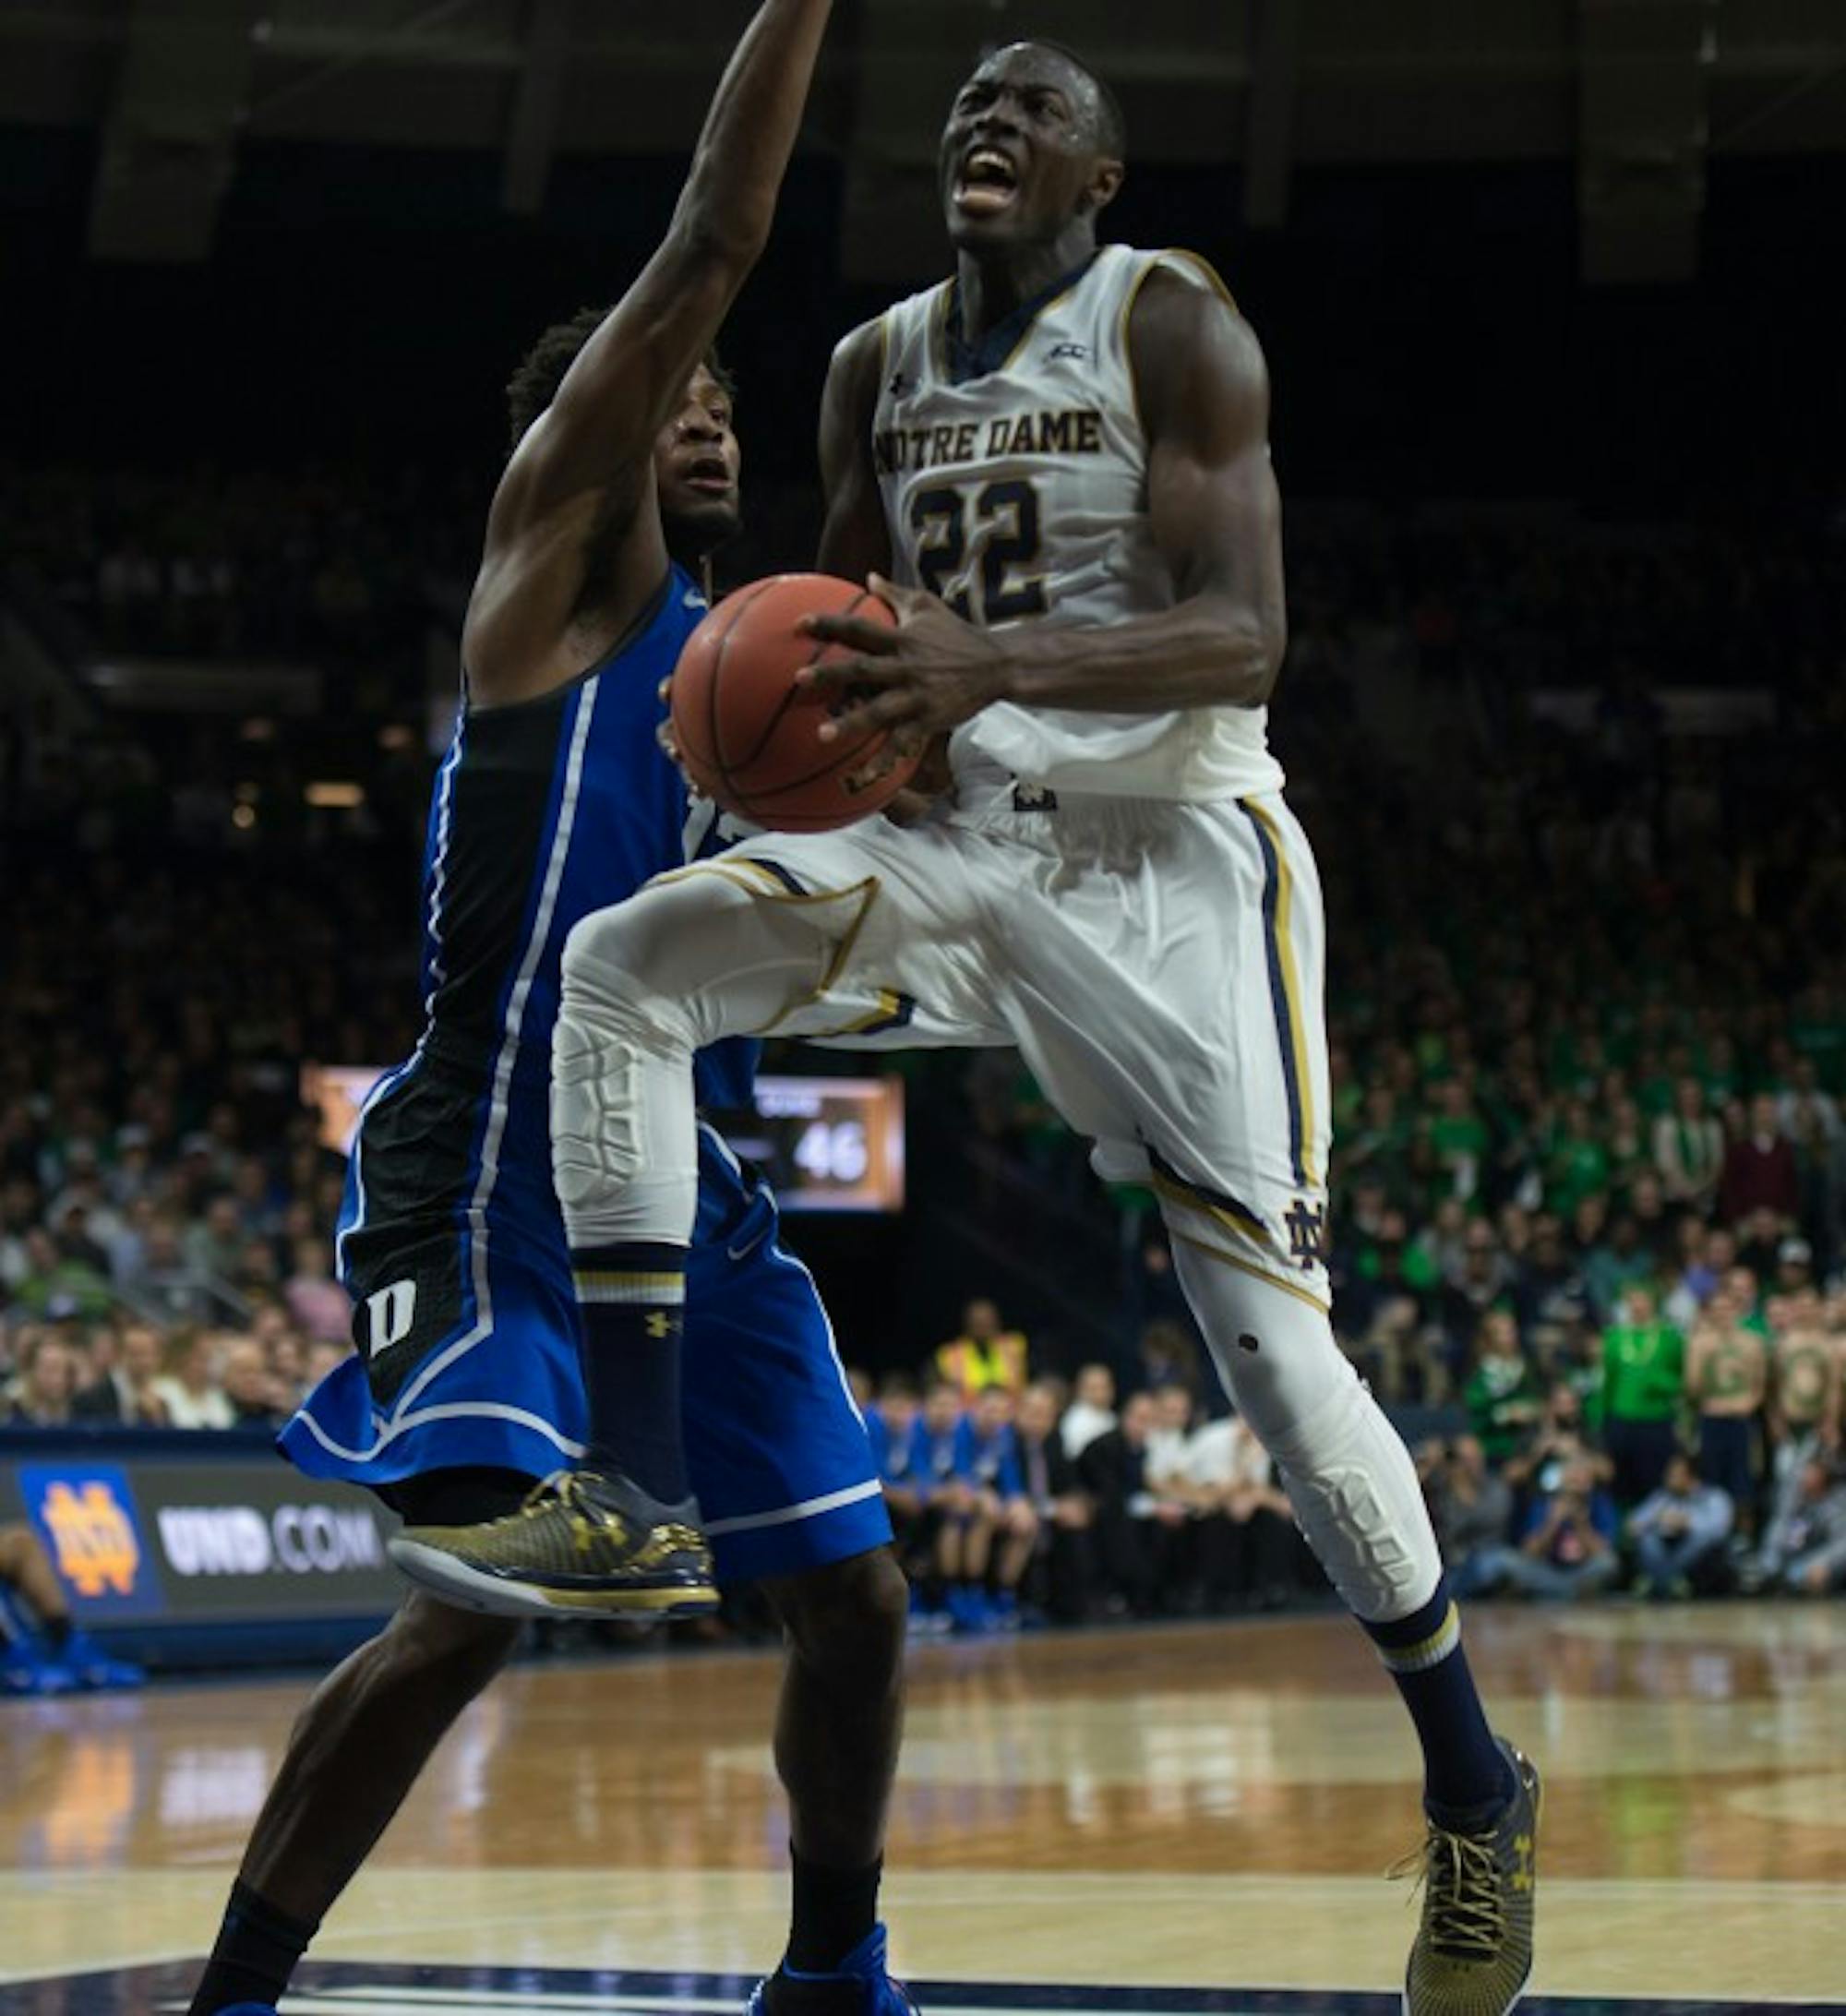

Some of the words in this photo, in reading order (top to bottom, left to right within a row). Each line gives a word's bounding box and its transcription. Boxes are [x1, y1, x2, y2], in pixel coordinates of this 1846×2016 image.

[876, 423, 978, 474] NOTRE
[986, 410, 1101, 458] DAME
[910, 478, 1048, 624] 22
[794, 1120, 869, 1182] 46
[366, 1278, 417, 1359] D
